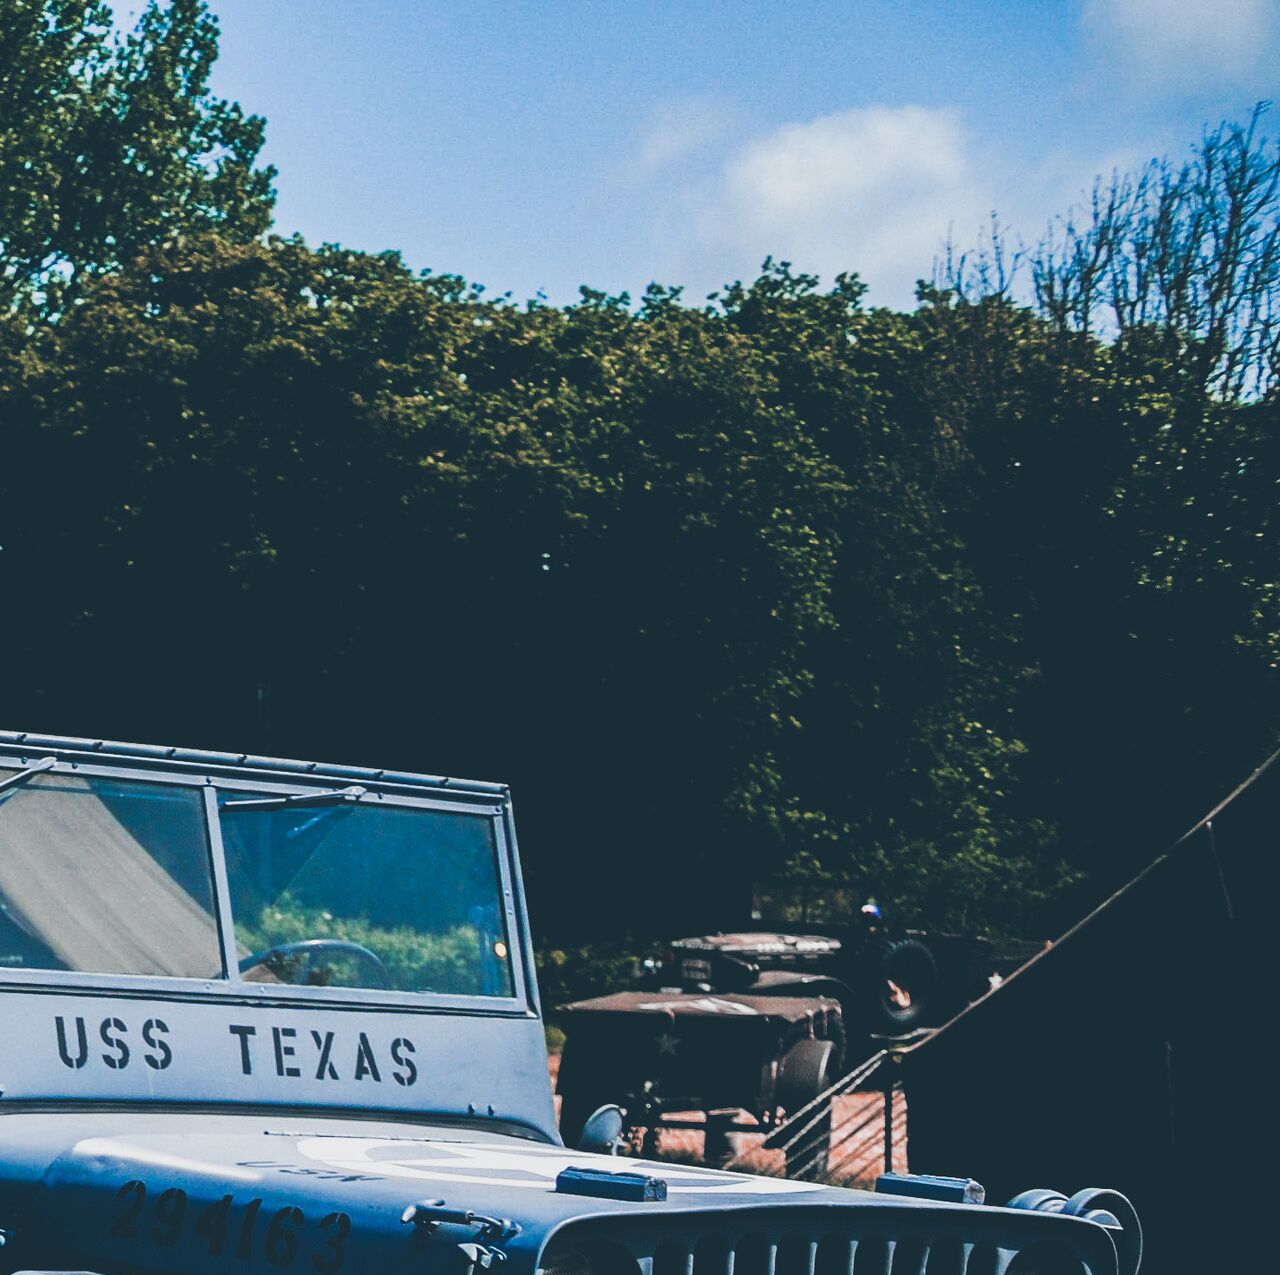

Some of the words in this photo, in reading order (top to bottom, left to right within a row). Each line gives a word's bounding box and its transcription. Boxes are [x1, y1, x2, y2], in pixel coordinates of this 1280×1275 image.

[55, 1016, 172, 1070] USS
[229, 1025, 418, 1086] TEXAS
[108, 1179, 352, 1275] 294163
